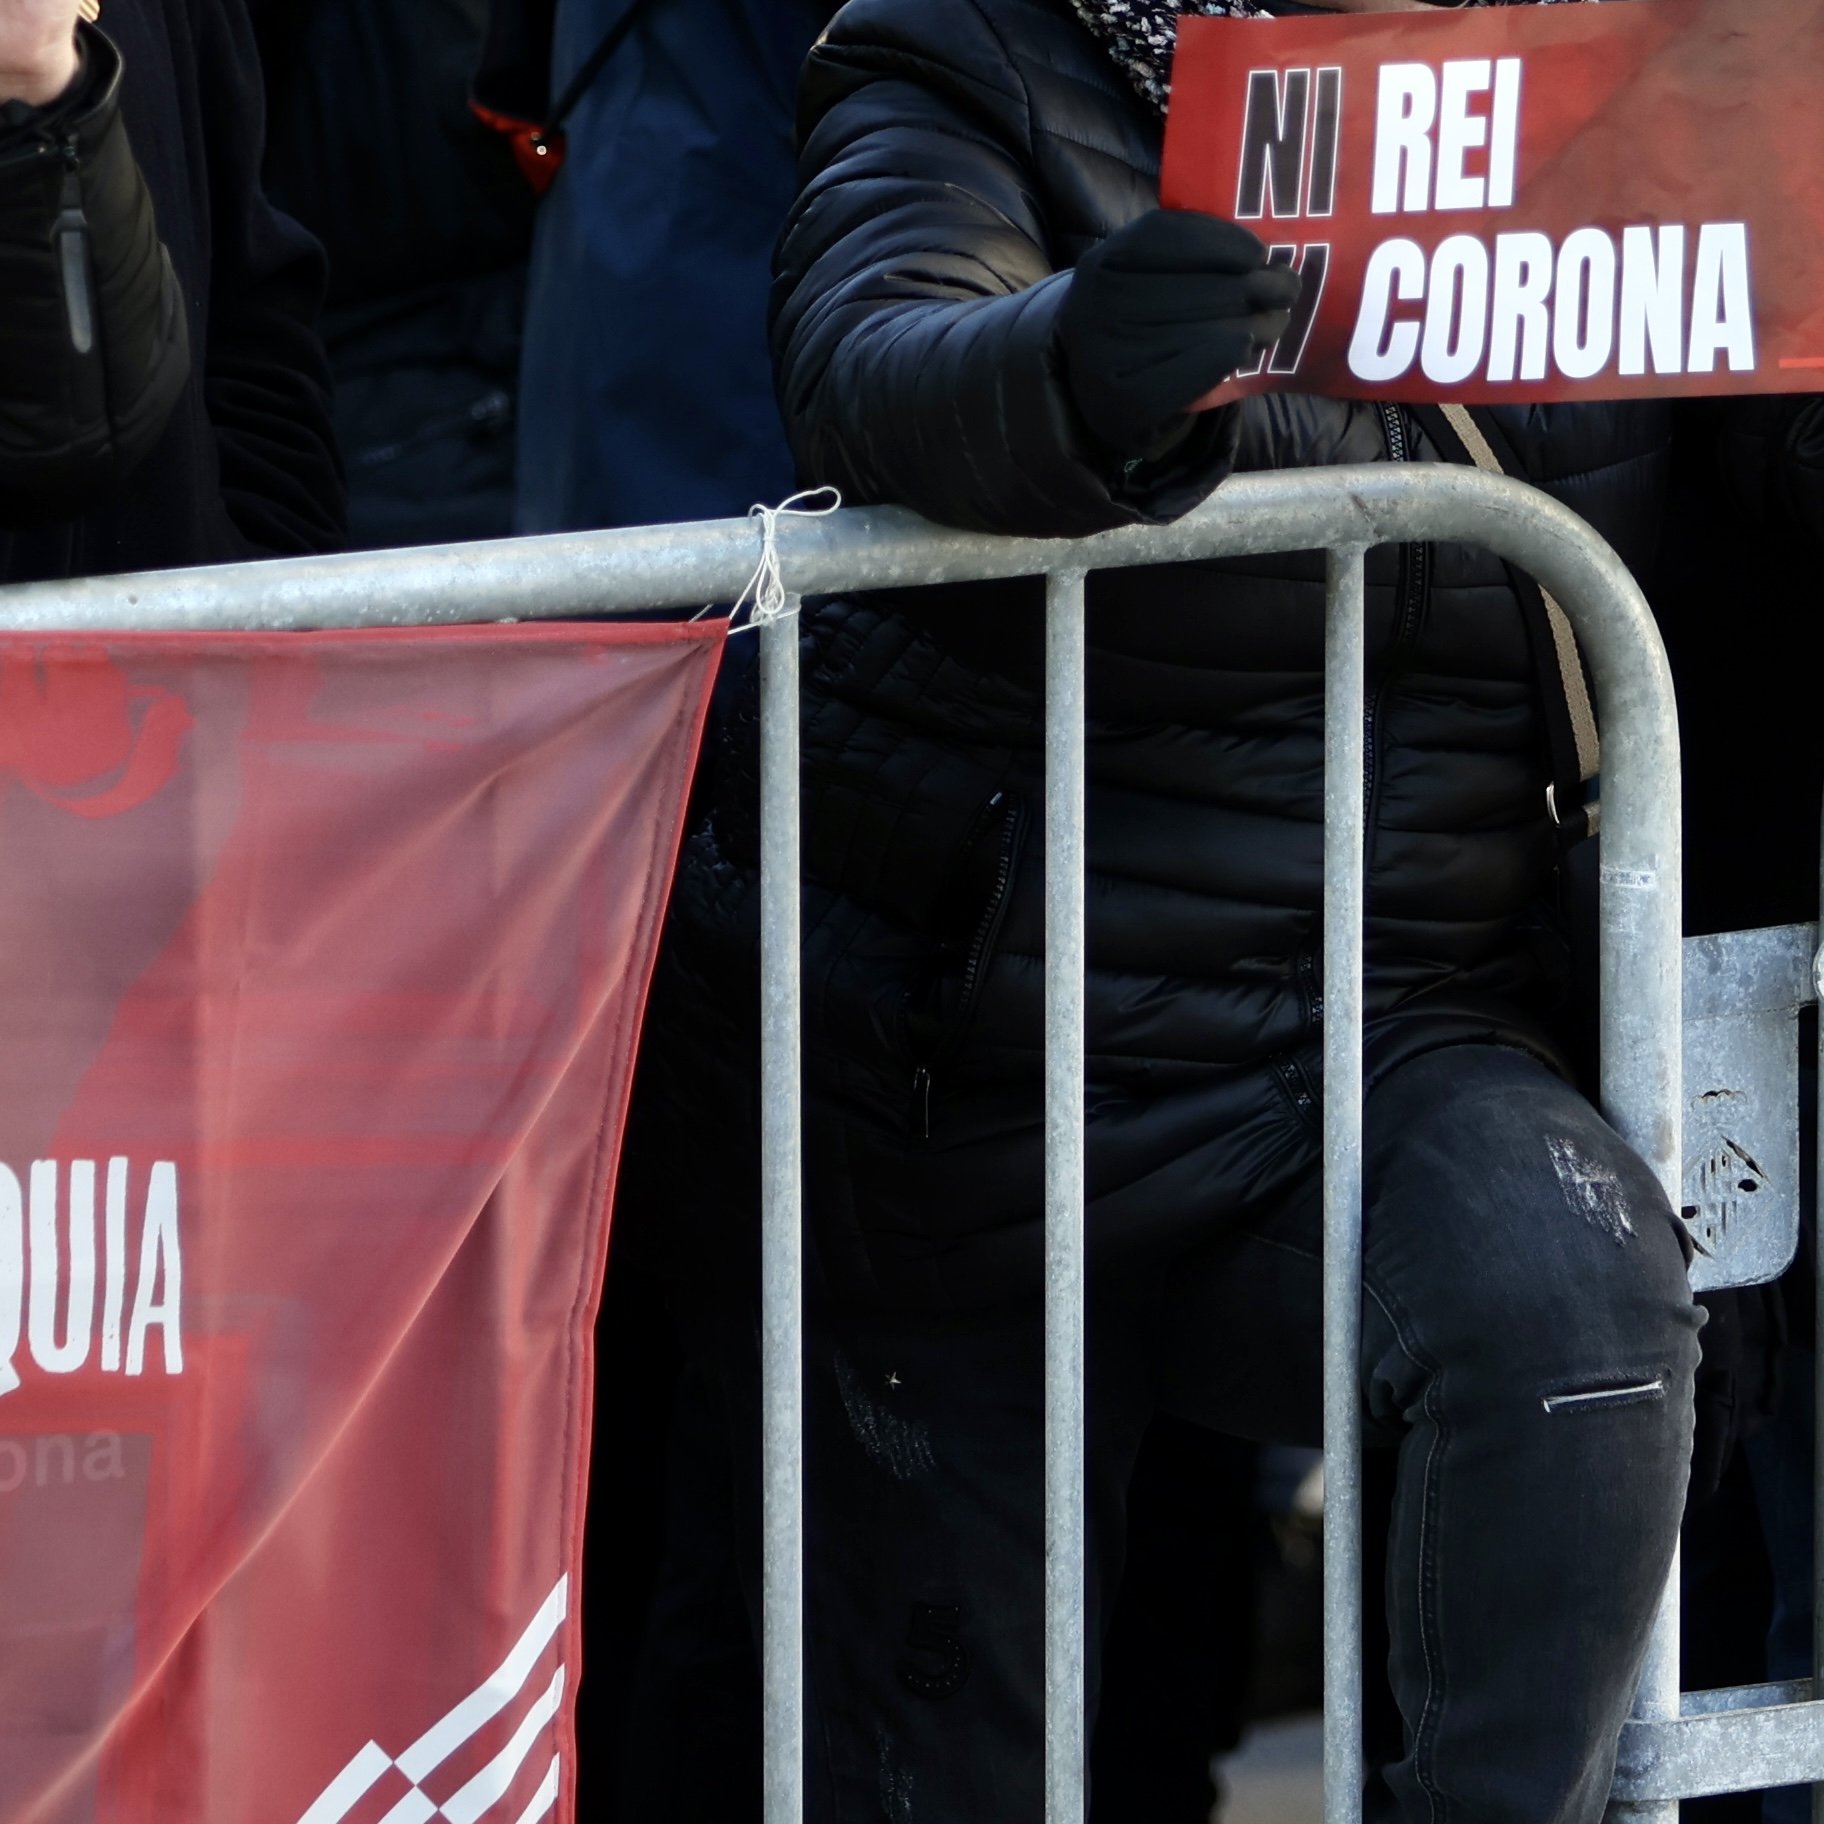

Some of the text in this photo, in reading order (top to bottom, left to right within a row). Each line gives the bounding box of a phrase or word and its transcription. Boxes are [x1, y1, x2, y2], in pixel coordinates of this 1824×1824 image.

[1234, 57, 1522, 220] NI REI
[1347, 222, 1756, 385] CORONA
